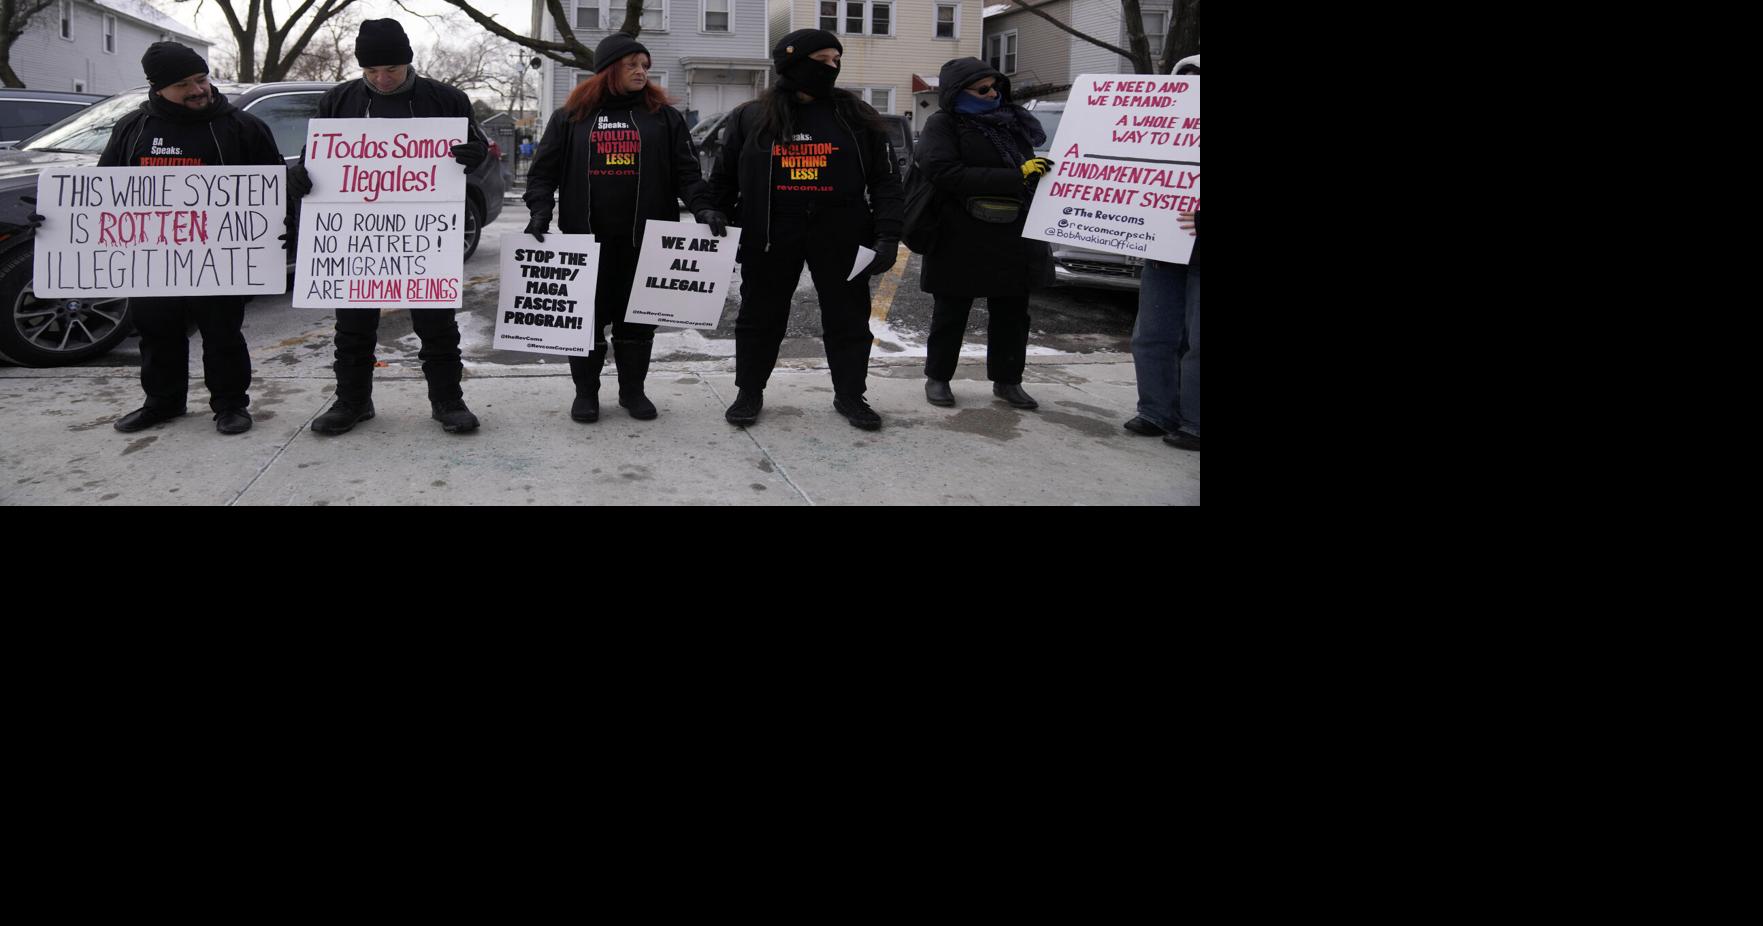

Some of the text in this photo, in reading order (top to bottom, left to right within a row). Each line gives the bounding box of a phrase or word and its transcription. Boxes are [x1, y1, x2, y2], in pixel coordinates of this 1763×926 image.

[1093, 81, 1189, 93] WE NEED AND
[1087, 95, 1177, 108] WE DEMAND:
[598, 122, 629, 130] Speaks:
[1115, 115, 1128, 126] A
[1133, 115, 1180, 129] WHOLE
[152, 137, 163, 146] BA
[591, 130, 640, 142] EVOLUTI
[792, 132, 813, 141] eaks:
[1112, 130, 1200, 148] WAY TO LIV
[151, 146, 183, 155] Speaks:
[311, 133, 388, 159] ¡Todos
[1064, 143, 1079, 158] A
[606, 153, 635, 165] LESS!
[781, 155, 827, 168] NOTHING
[790, 168, 819, 180] LESS!
[1058, 161, 1200, 189] FUNDAMENTALLY
[52, 174, 279, 207] THIS WHOLE SYSTEM
[339, 165, 437, 203] Ilegales!
[1050, 182, 1140, 205] DIFFERENT
[69, 210, 268, 248] IS ROTTEN AND
[315, 212, 457, 232] NO ROUND UPS!
[313, 235, 338, 253] NO
[661, 235, 720, 253] WE ARE
[1044, 227, 1148, 252] @BobAvakianOfficial
[311, 256, 426, 276] IMMIGRANTS
[514, 248, 588, 266] STOP THE
[670, 258, 700, 272] ALL
[48, 247, 265, 289] ILLEGITIMATE
[520, 264, 580, 281] TRUMP/
[307, 278, 458, 301] ARE HUMAN BEINGS
[526, 281, 568, 297] MAGA
[645, 276, 715, 294] ILLEGAL!
[514, 296, 578, 313] FASCIST
[504, 311, 583, 330] PROGRAM!
